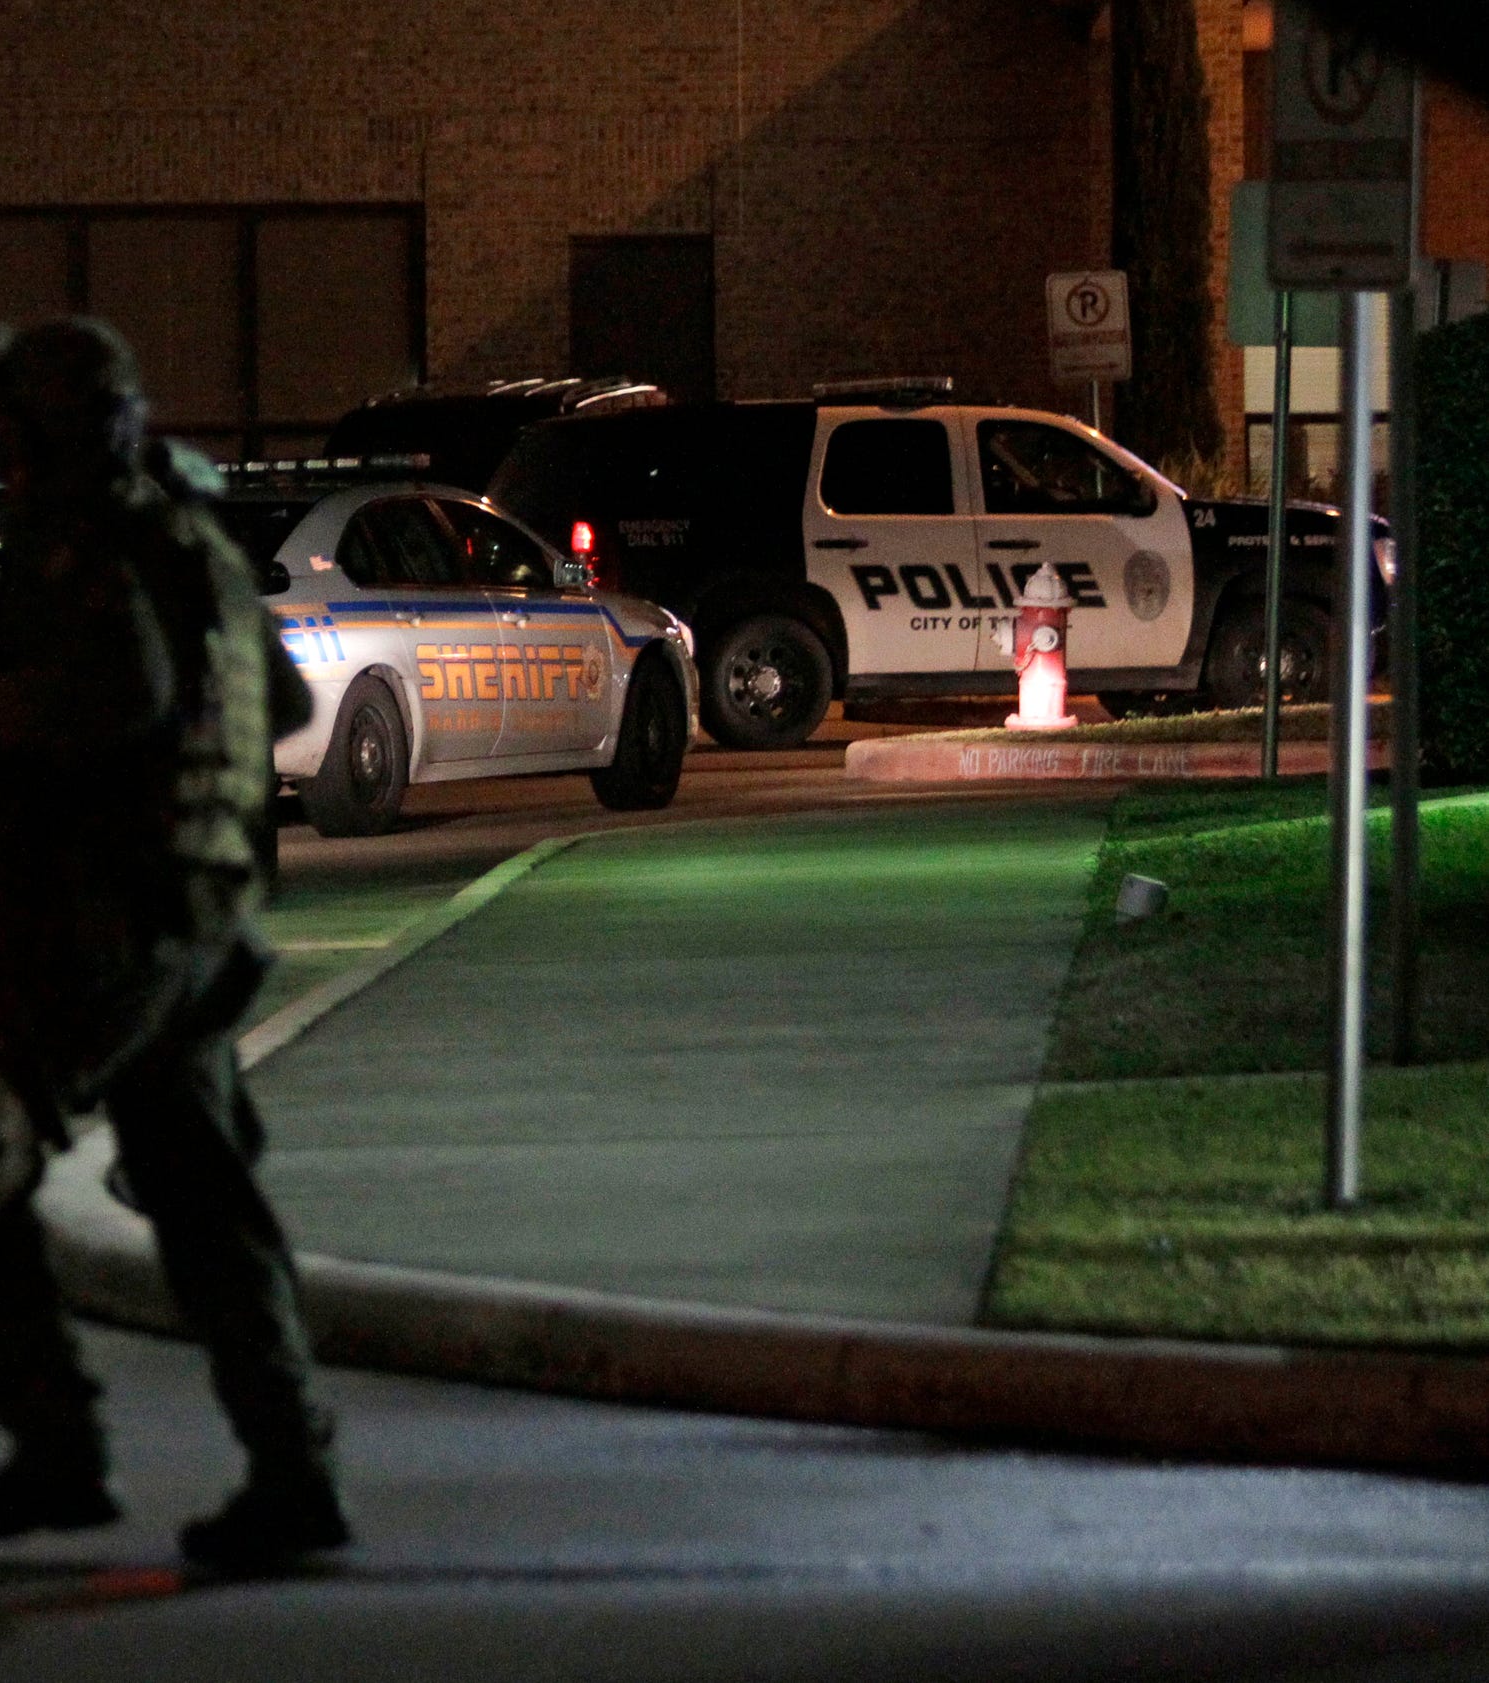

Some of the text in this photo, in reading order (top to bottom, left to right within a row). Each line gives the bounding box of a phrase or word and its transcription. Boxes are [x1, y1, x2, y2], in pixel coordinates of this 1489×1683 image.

[1193, 508, 1217, 528] 24
[910, 617, 952, 631] CITY
[959, 617, 981, 631] OF
[416, 643, 585, 701] SHERIFF
[959, 748, 981, 777] NO
[987, 747, 1061, 775] PARKING
[1079, 748, 1127, 778] FIRE
